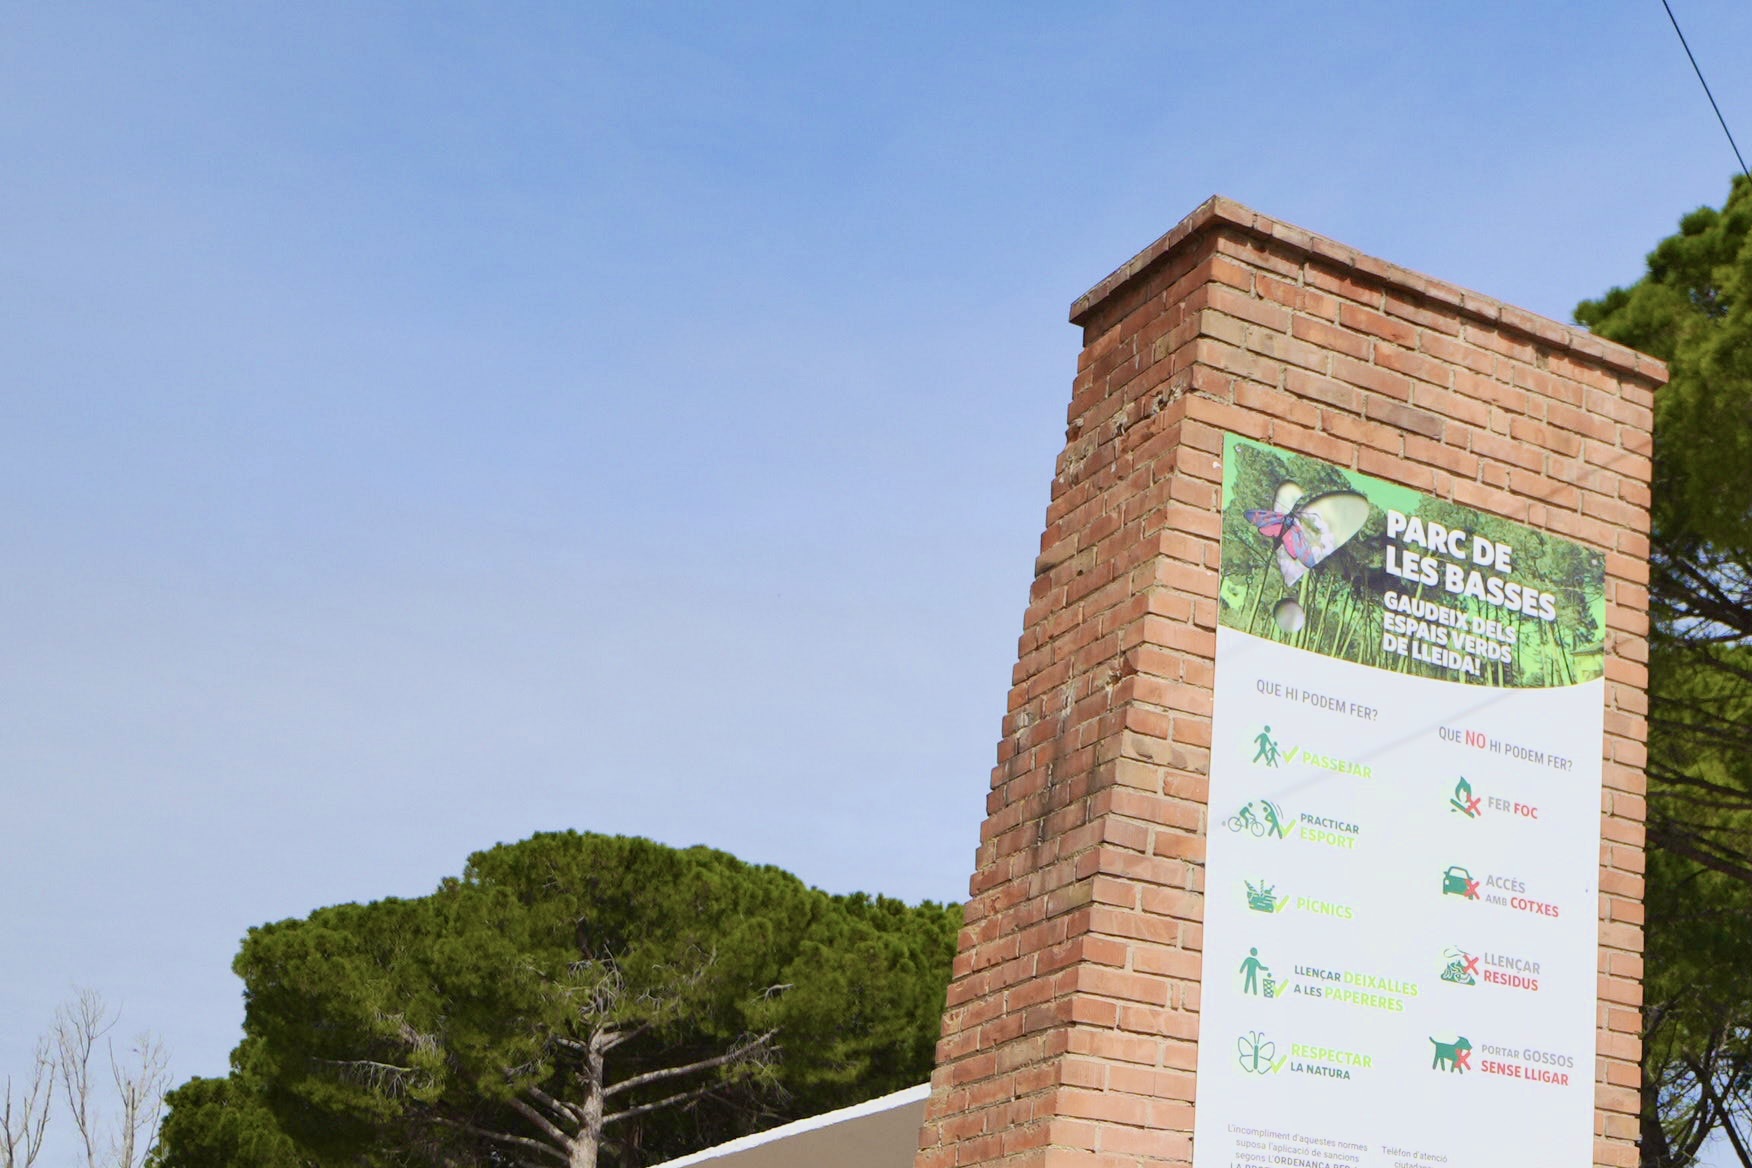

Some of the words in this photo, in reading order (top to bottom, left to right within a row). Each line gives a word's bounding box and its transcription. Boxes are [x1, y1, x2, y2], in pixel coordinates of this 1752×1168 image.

[1387, 510, 1467, 560] PARC
[1473, 538, 1512, 574] DE
[1386, 546, 1439, 587] LES
[1445, 563, 1556, 621] BASSES
[1384, 591, 1468, 631] GAUDEIX
[1472, 616, 1517, 643] DELS
[1383, 612, 1448, 646] ESPAIS
[1451, 630, 1512, 664] VERDS
[1383, 634, 1408, 655] DE
[1411, 640, 1481, 676] LLEIDA!
[1256, 679, 1281, 696] QUE
[1286, 686, 1298, 701] HI
[1303, 691, 1346, 713] PODEM
[1350, 703, 1378, 721] FER?
[1439, 726, 1462, 743] QUE
[1466, 730, 1486, 749] NO
[1490, 740, 1500, 754] HI
[1505, 744, 1544, 765] PODEM
[1548, 755, 1573, 772] FER?
[1303, 751, 1372, 779] PASSEJAR
[1488, 796, 1510, 812] FER
[1514, 803, 1538, 819] FOC
[1301, 813, 1360, 834] PRACTICAR
[1300, 828, 1356, 849] ESPORT
[1486, 875, 1526, 894] ACCÉS
[1485, 894, 1507, 906] AMB
[1510, 897, 1559, 918] COTXES
[1484, 952, 1540, 974] LLENÇAR
[1295, 965, 1341, 982] LLENÇAR
[1344, 971, 1418, 996] DEIXALLES
[1484, 970, 1539, 991] RESIDUS
[1294, 984, 1301, 994] A
[1304, 985, 1322, 997] LES
[1325, 986, 1404, 1012] PAPERERES
[1291, 1043, 1372, 1068] RESPECTAR
[1482, 1044, 1519, 1059] PORTAR
[1523, 1049, 1574, 1068] GOSSOS
[1291, 1062, 1303, 1073] LA
[1306, 1064, 1351, 1080] NATURA
[1481, 1060, 1521, 1078] SENSE
[1525, 1068, 1568, 1086] LLIGAR
[1235, 1152, 1265, 1163] segons
[1236, 1139, 1266, 1152] suposa
[1312, 1148, 1321, 1157] de
[1324, 1151, 1359, 1163] sancions
[1338, 1140, 1368, 1152] normes
